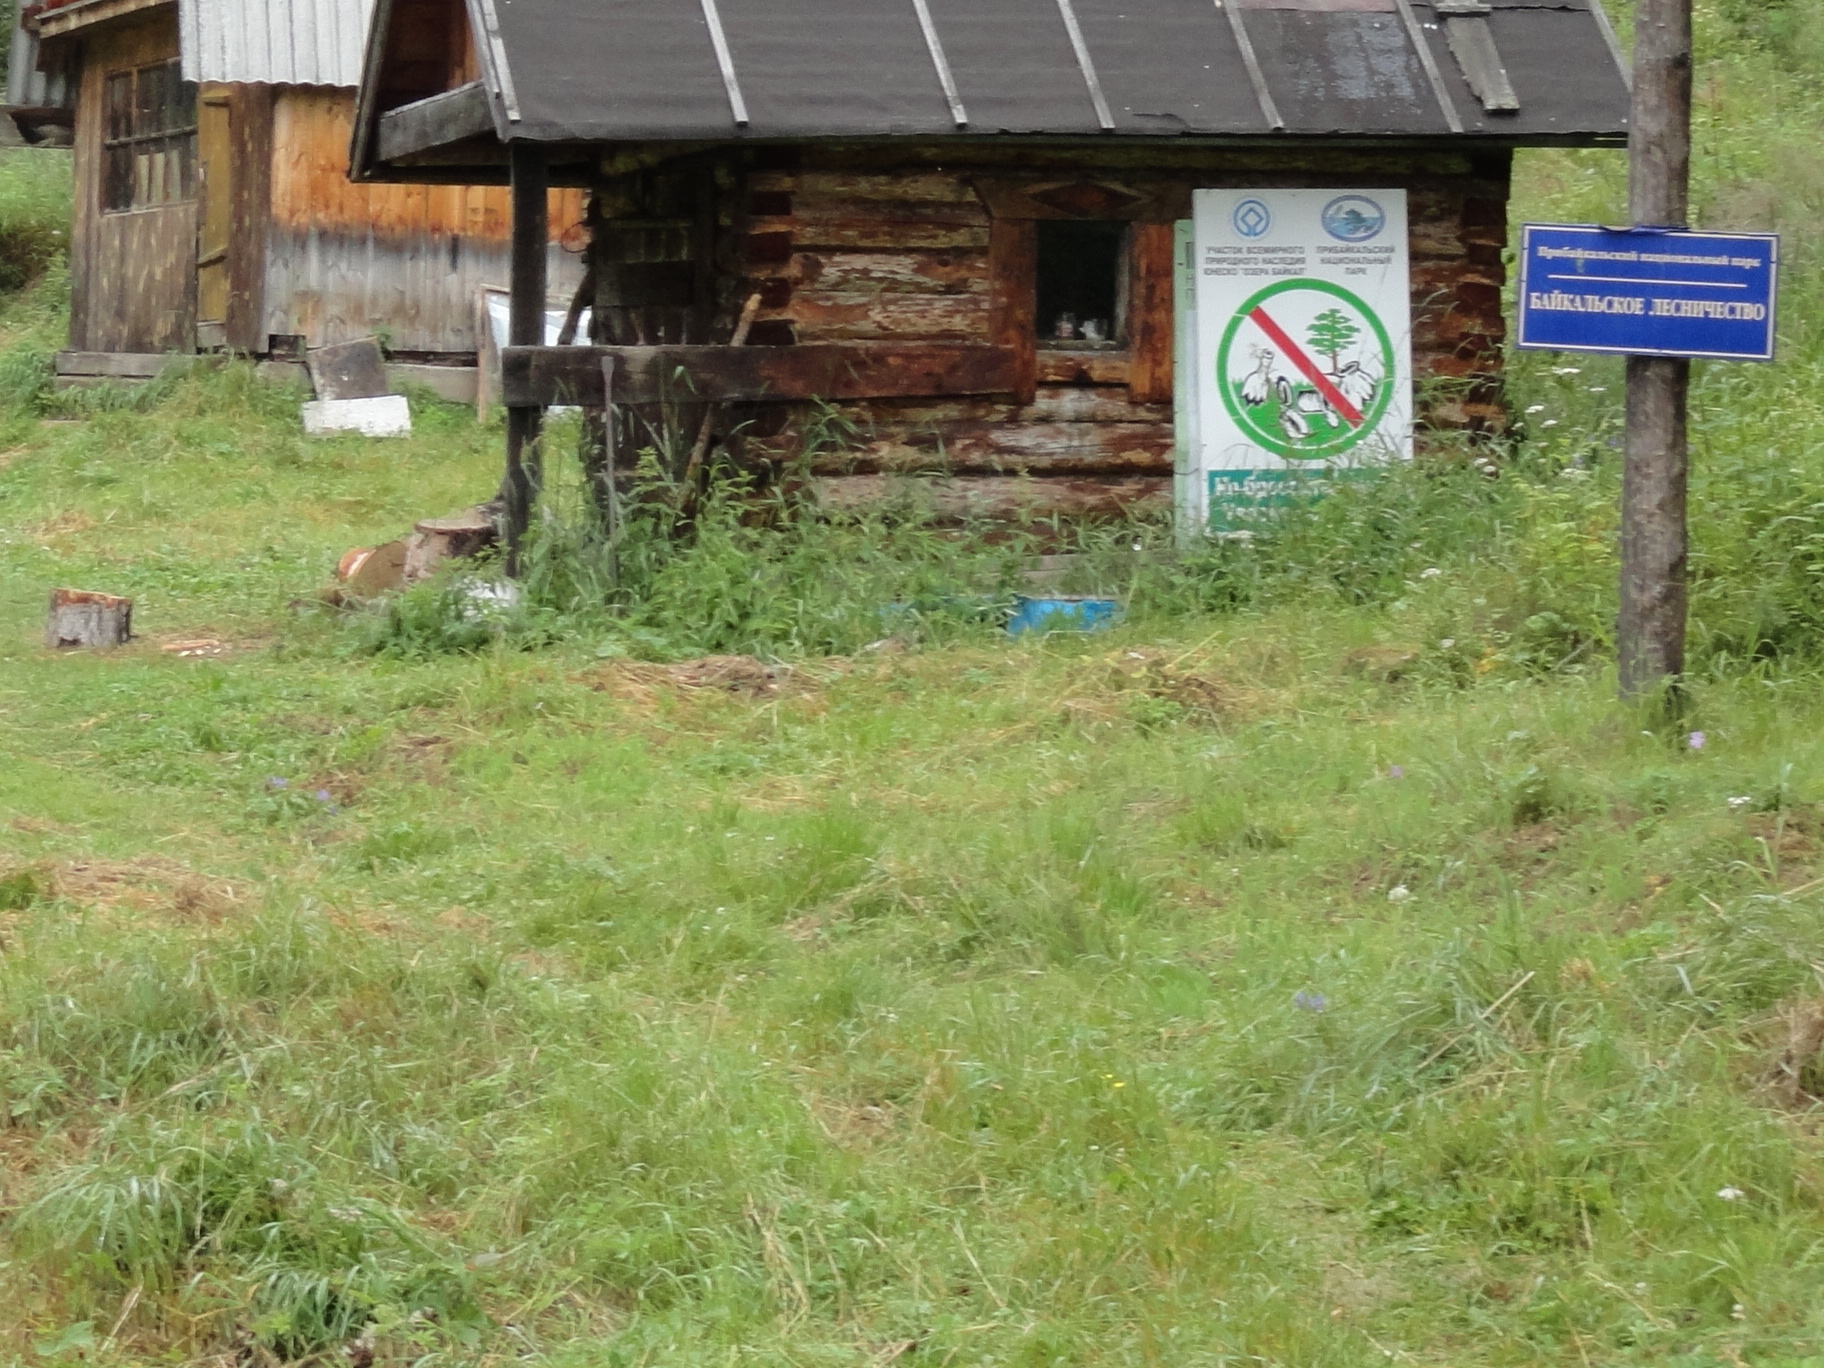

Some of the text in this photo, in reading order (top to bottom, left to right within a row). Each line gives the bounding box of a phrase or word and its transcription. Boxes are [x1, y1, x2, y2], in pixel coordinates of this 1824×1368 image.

[1246, 245, 1306, 255] ВСЕМИРНОГО
[1316, 244, 1396, 254] ПРИБАЙКАЛЬСКИЙ
[1261, 256, 1307, 266] НАСЛЕДИЯ
[1319, 255, 1393, 265] НАЦИОНАЛЬНЫЙ
[1537, 245, 1762, 269] Прибайкальский национальный парк
[1344, 266, 1368, 276] ПАРК
[1529, 289, 1766, 321] БАЙКАЛЬСКОЕ ЛЕСНИЧЕСТВО
